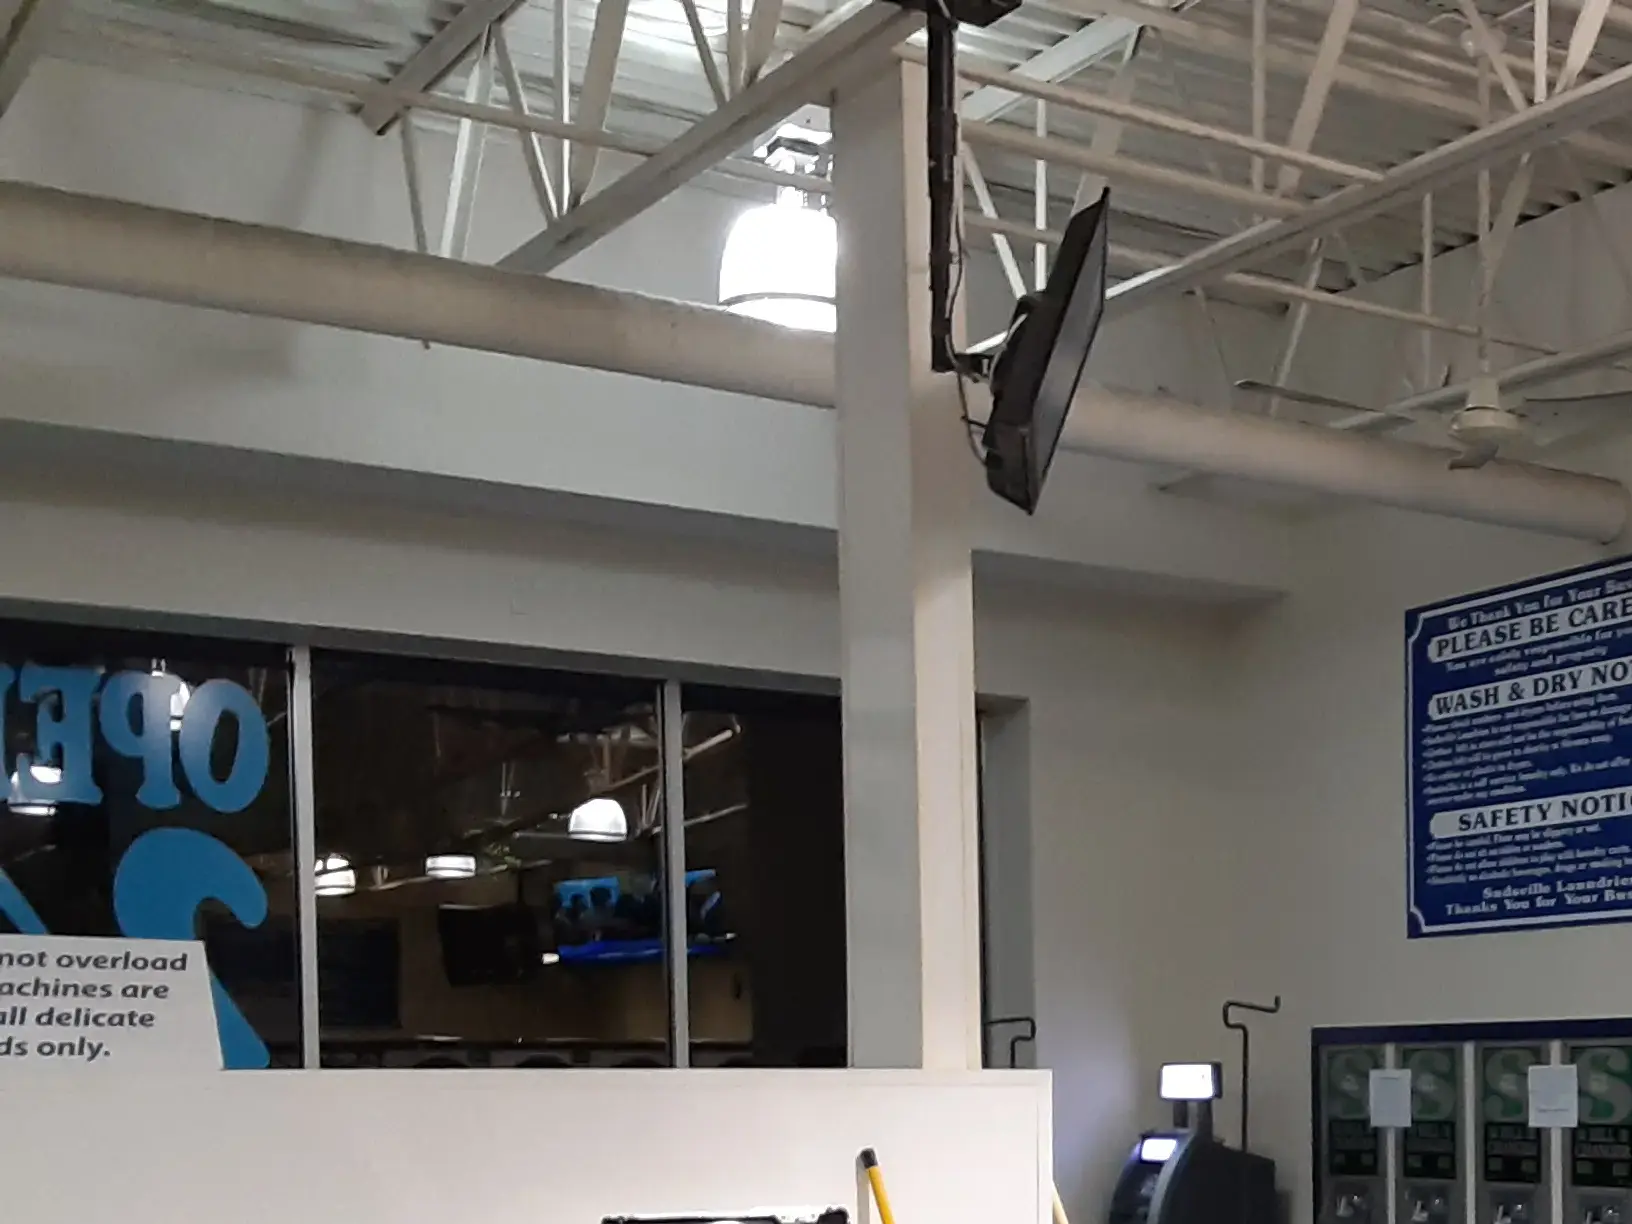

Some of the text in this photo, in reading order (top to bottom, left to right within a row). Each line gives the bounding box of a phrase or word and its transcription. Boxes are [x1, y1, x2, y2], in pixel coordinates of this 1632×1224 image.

[1567, 587, 1601, 603] Your
[1436, 622, 1522, 657] PLEASE
[1530, 616, 1559, 637] BE
[1436, 686, 1500, 715] WASH
[1508, 682, 1524, 701] &
[1533, 670, 1584, 696] DRY
[1458, 803, 1552, 831] SAFETY
[1504, 899, 1530, 910] You
[1564, 893, 1599, 904] Your
[0, 951, 188, 971] not overload
[121, 984, 169, 999] are
[35, 1007, 155, 1027] delicate
[36, 1036, 110, 1062] only.
